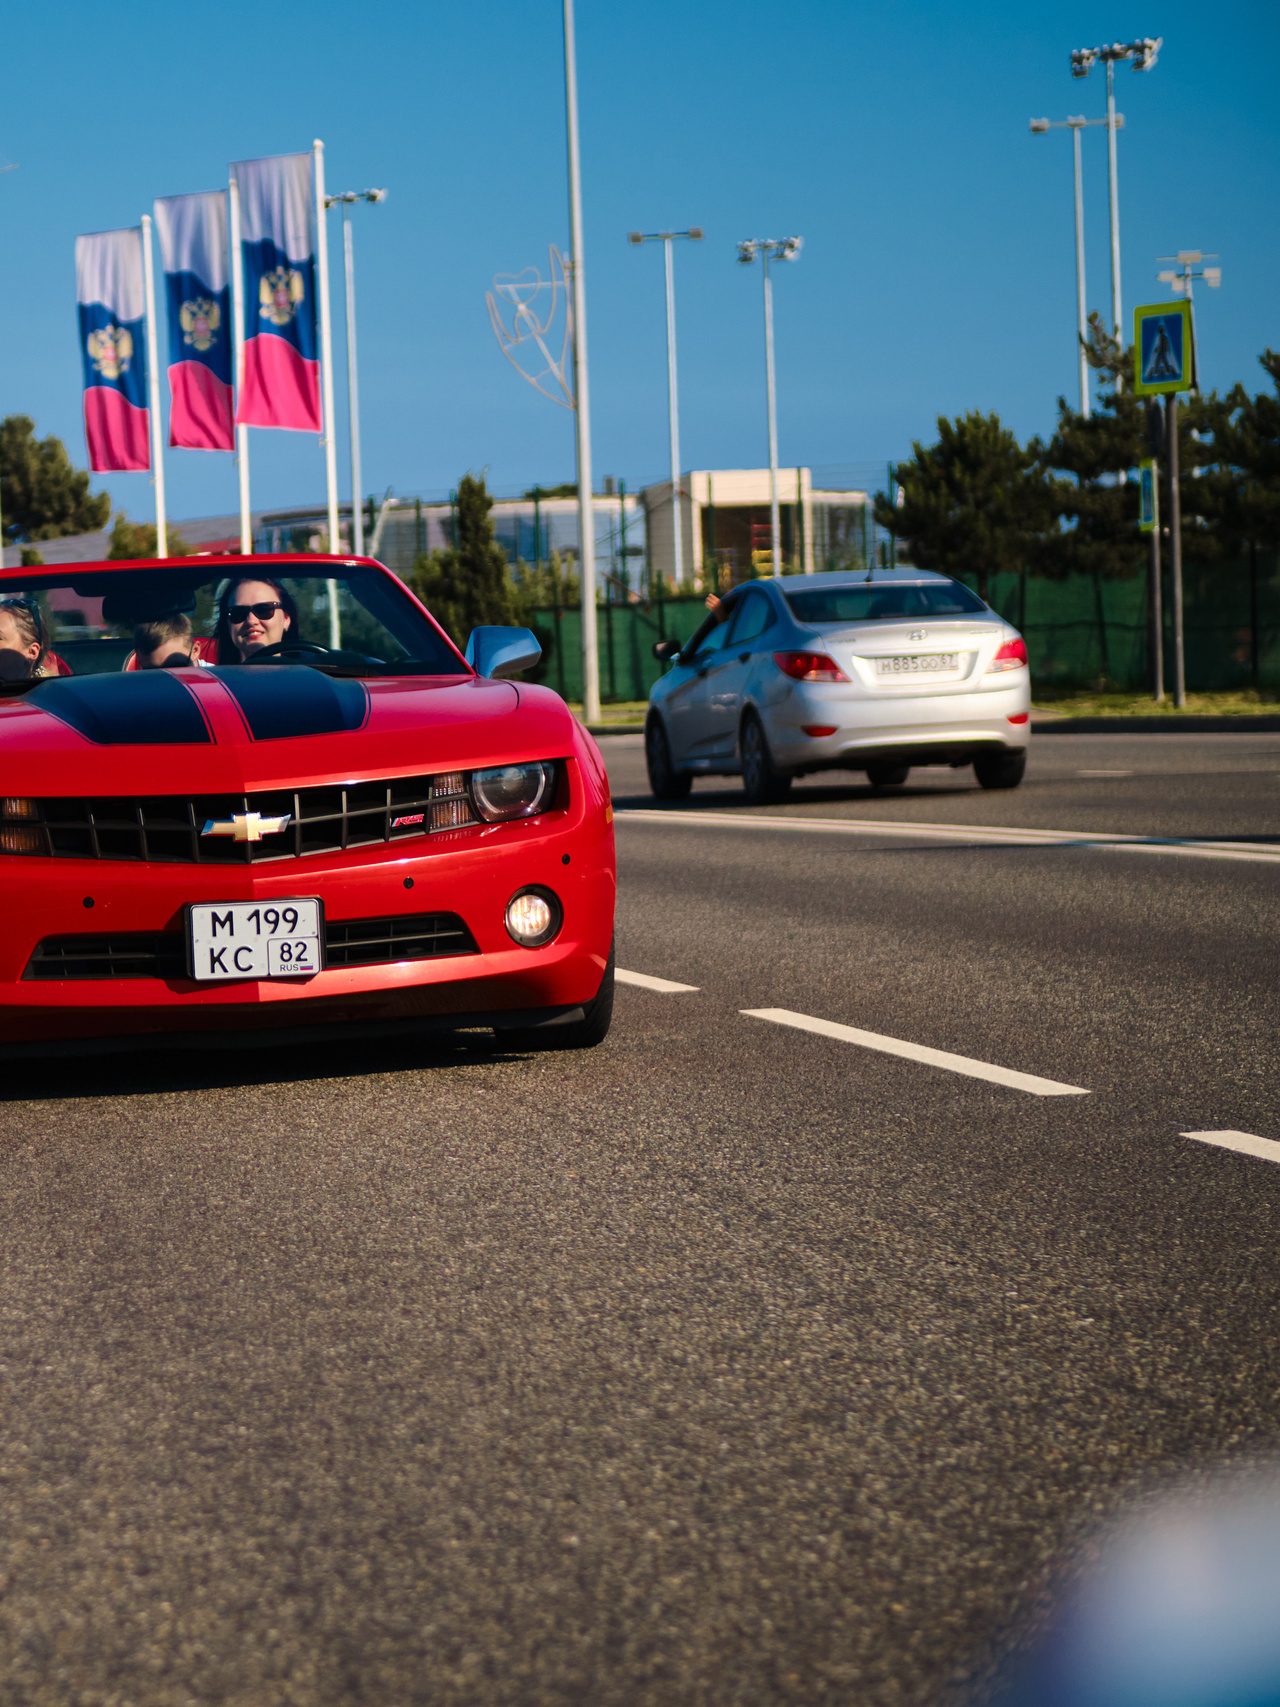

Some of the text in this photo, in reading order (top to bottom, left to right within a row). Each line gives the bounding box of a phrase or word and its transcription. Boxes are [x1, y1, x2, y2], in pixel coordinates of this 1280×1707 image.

[210, 907, 299, 937] М 199
[209, 941, 308, 974] КС 82
[279, 963, 299, 972] RUS
